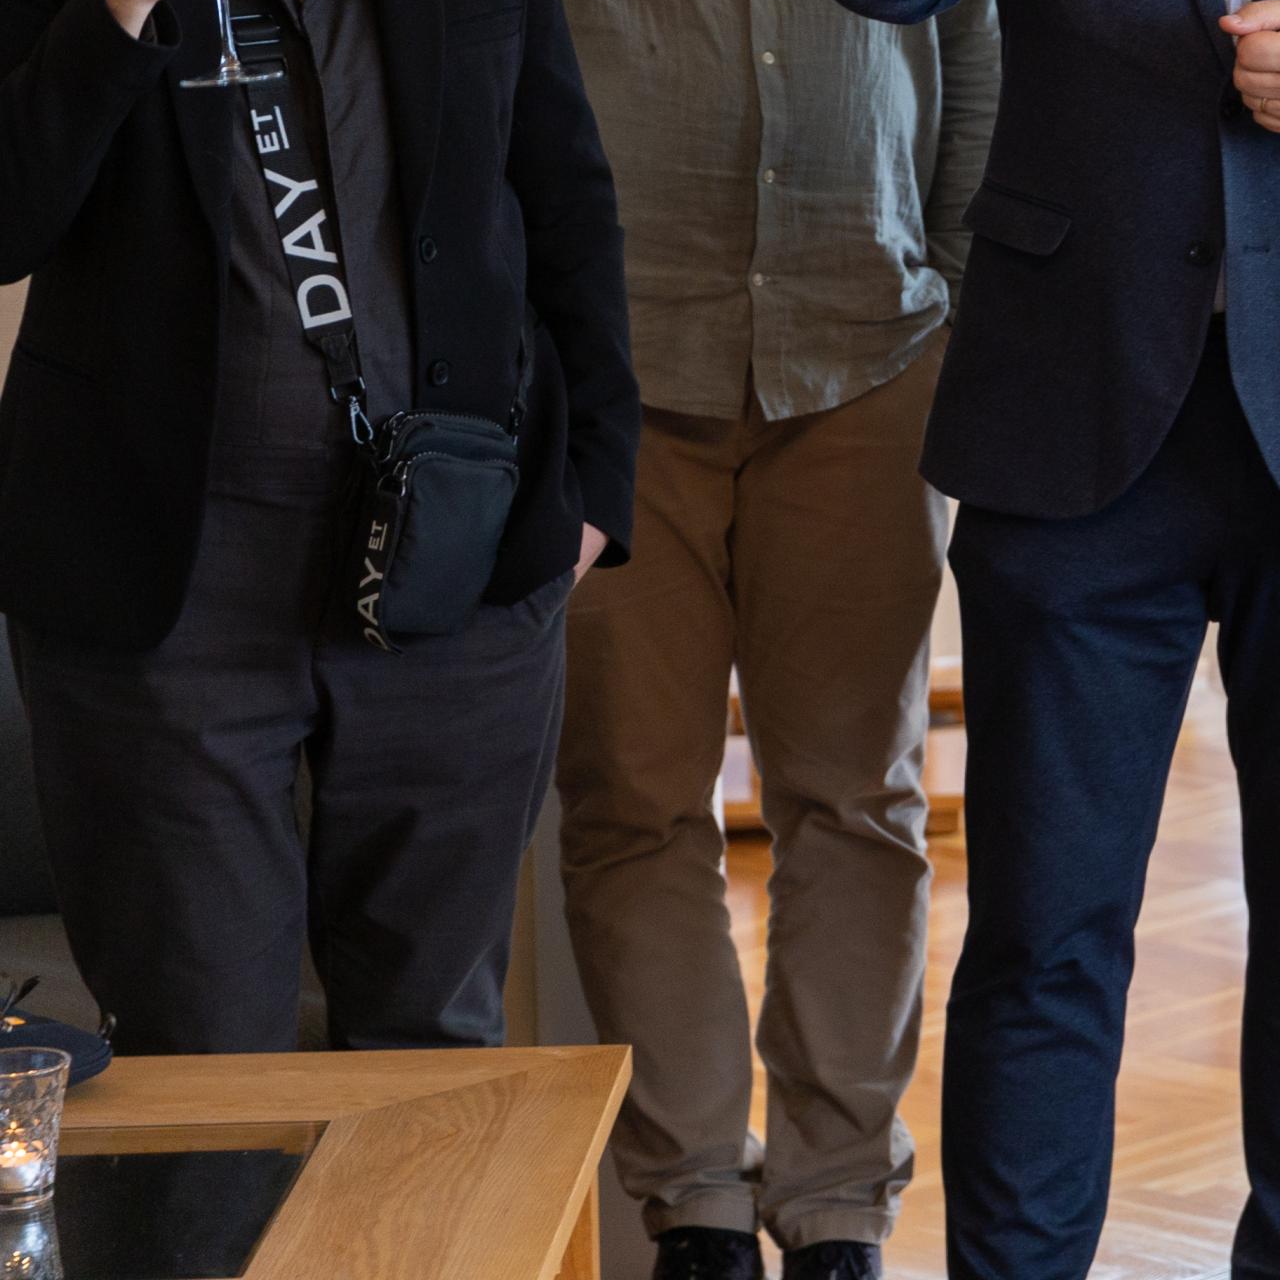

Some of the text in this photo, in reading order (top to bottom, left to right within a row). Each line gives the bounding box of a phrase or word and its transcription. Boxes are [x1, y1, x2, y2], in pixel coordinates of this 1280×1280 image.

[251, 106, 353, 330] DAY ET
[368, 520, 386, 552] ET
